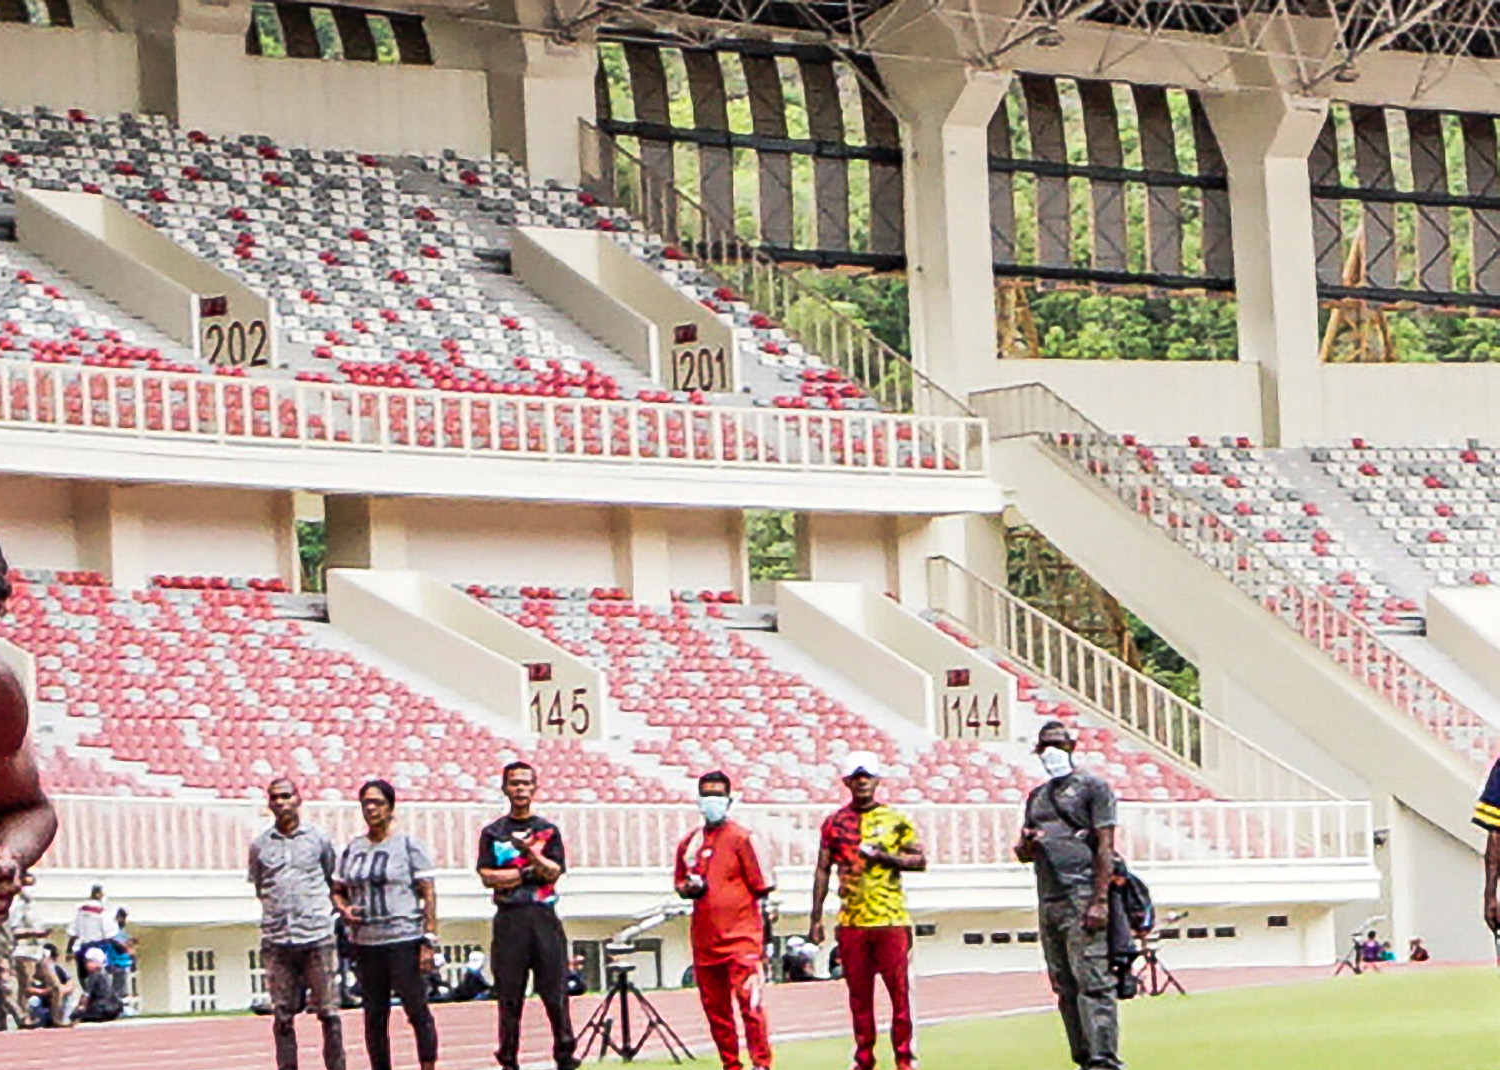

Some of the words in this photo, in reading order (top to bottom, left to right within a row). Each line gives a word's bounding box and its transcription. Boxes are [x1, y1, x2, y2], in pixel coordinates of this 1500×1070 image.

[205, 320, 269, 367] 202
[530, 687, 590, 735] 145
[950, 692, 1001, 738] 144
